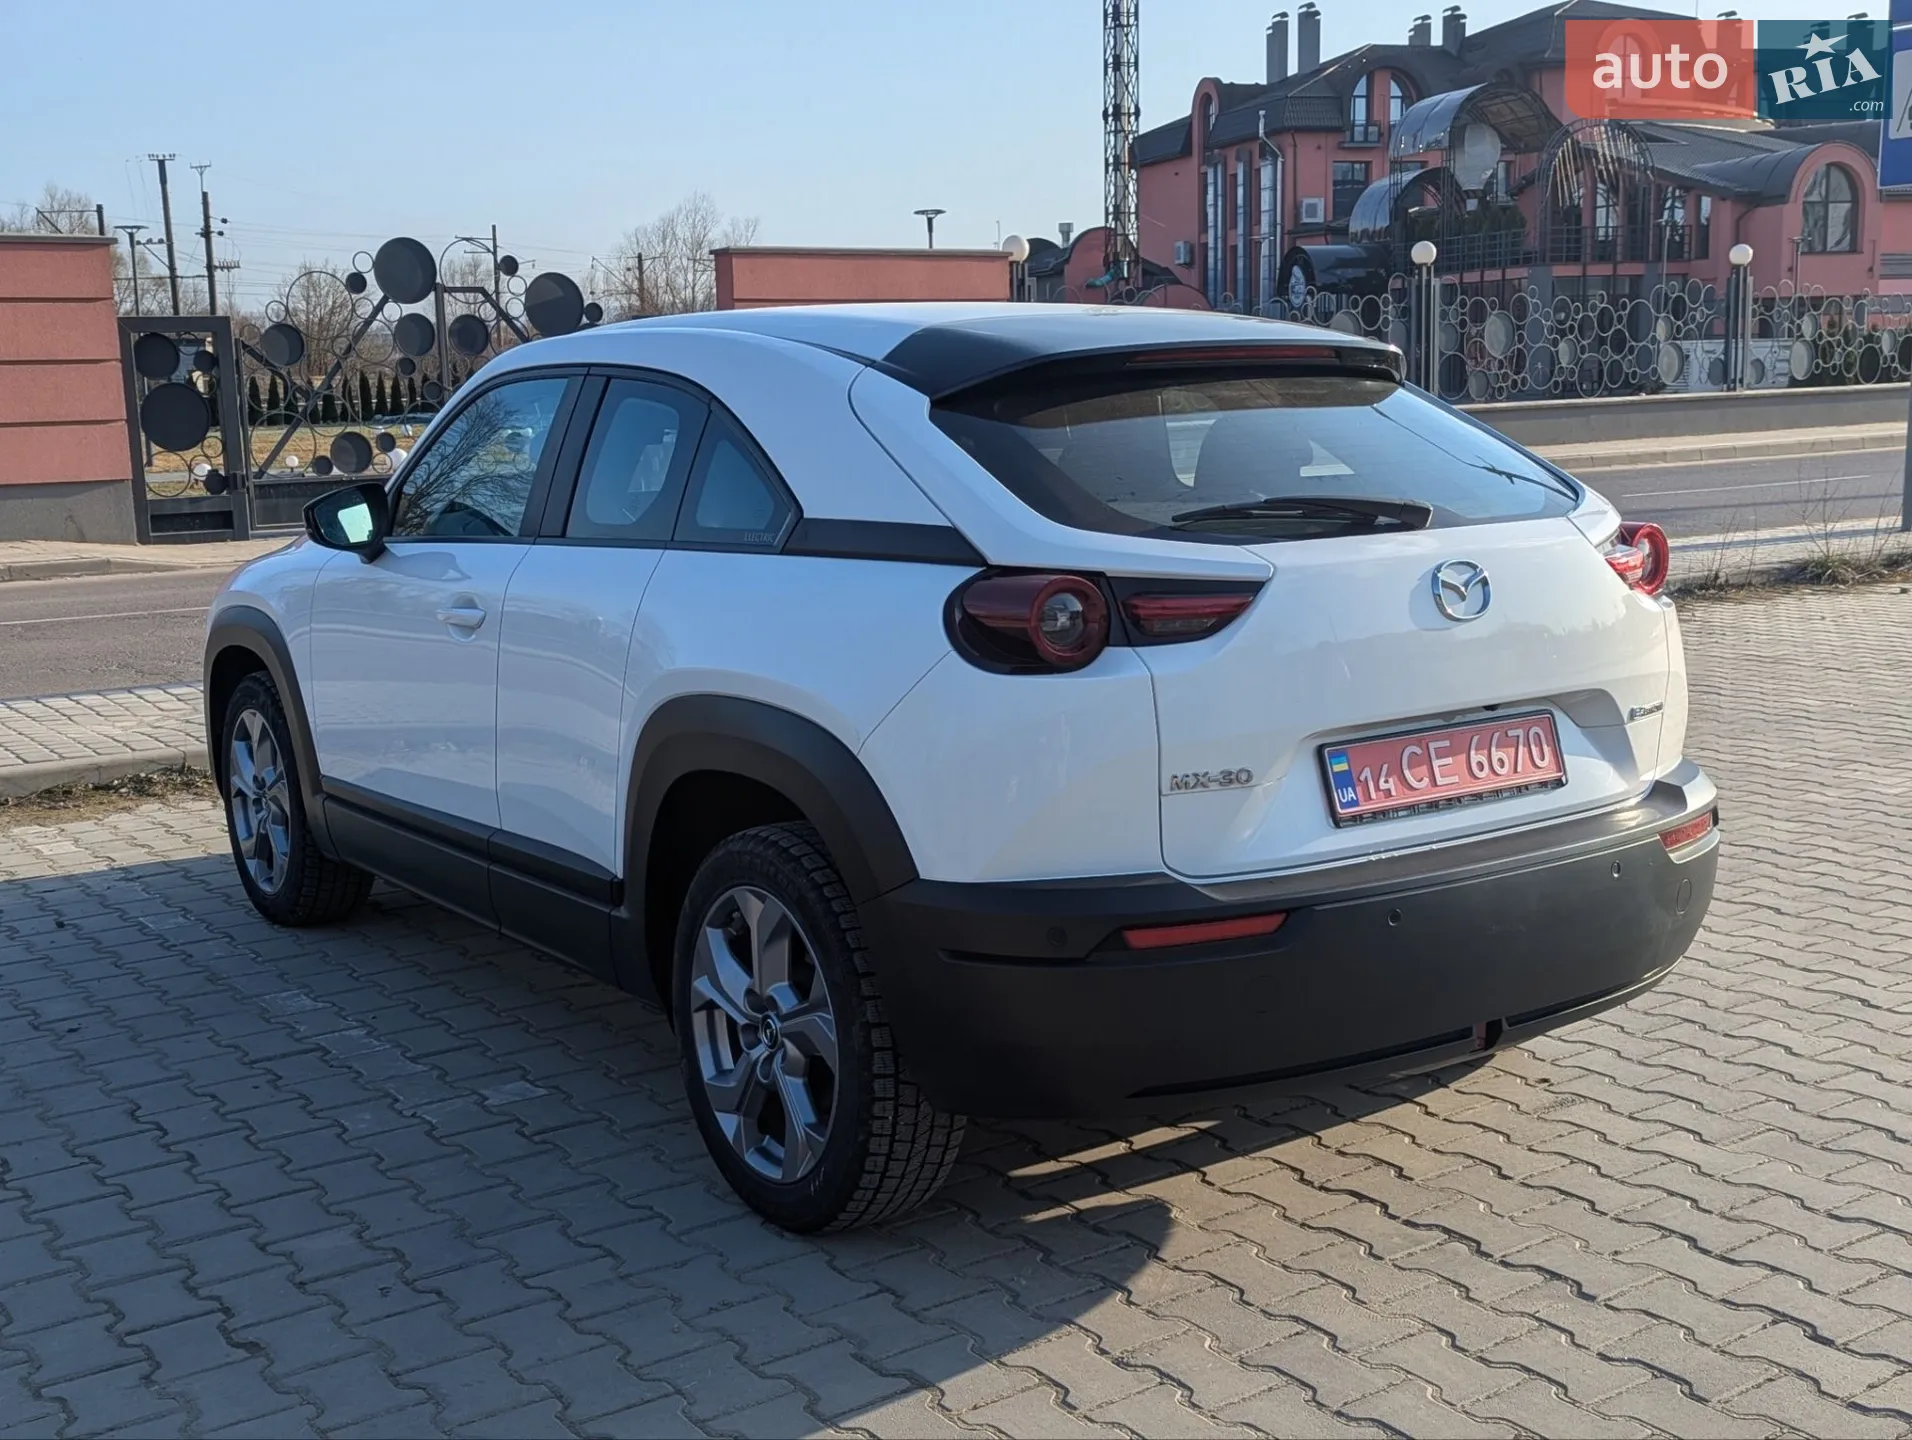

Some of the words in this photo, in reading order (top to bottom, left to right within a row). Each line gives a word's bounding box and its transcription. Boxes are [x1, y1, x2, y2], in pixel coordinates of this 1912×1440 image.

[1359, 763, 1396, 800] 14
[1400, 740, 1459, 790] CE
[1468, 725, 1550, 780] 6670
[1169, 766, 1254, 791] MX-30
[1338, 787, 1358, 803] UA
